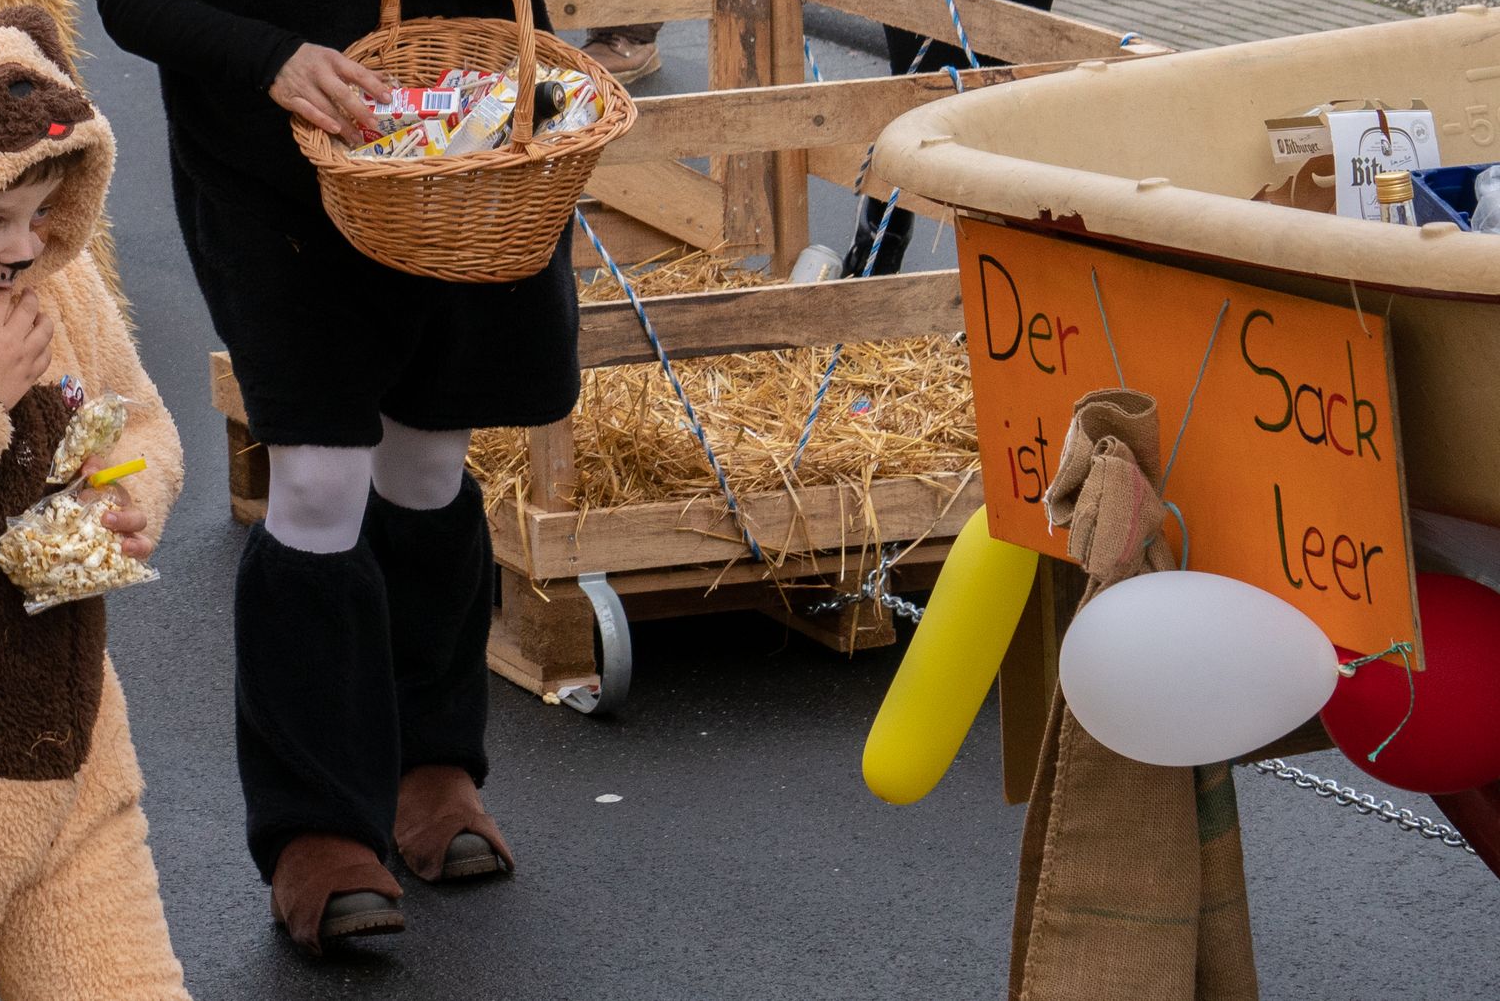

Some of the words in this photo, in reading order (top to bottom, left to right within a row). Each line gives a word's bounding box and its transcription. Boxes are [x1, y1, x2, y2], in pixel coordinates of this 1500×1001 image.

[1284, 138, 1323, 155] Bitburger
[979, 254, 1079, 375] Der
[1241, 309, 1381, 462] Sack
[1004, 416, 1049, 504] ist
[1274, 483, 1383, 605] leer
